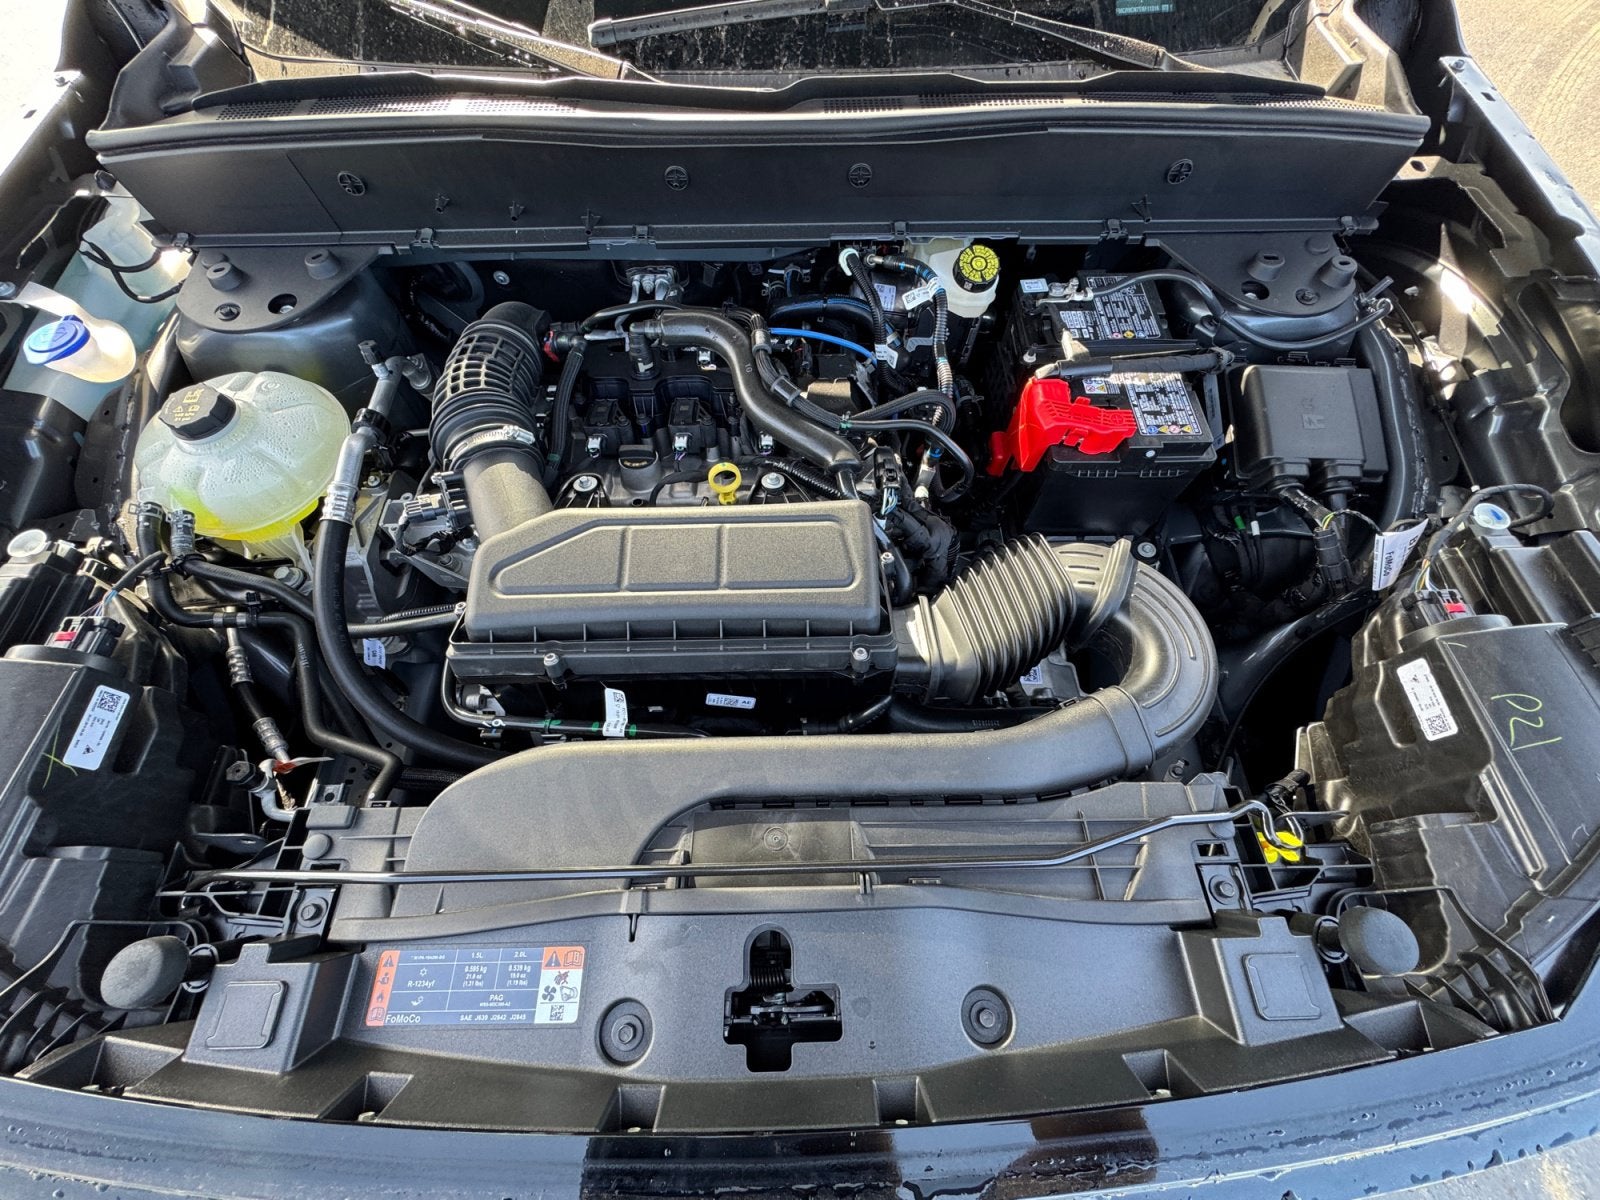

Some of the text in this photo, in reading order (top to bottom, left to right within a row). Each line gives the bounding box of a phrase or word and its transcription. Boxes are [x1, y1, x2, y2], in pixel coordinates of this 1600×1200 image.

[1383, 551, 1394, 576] FoMoCo
[480, 965, 488, 974] kg
[523, 964, 531, 973] kg
[407, 980, 436, 988] R-1234yf
[385, 1014, 420, 1024] FoMoCo
